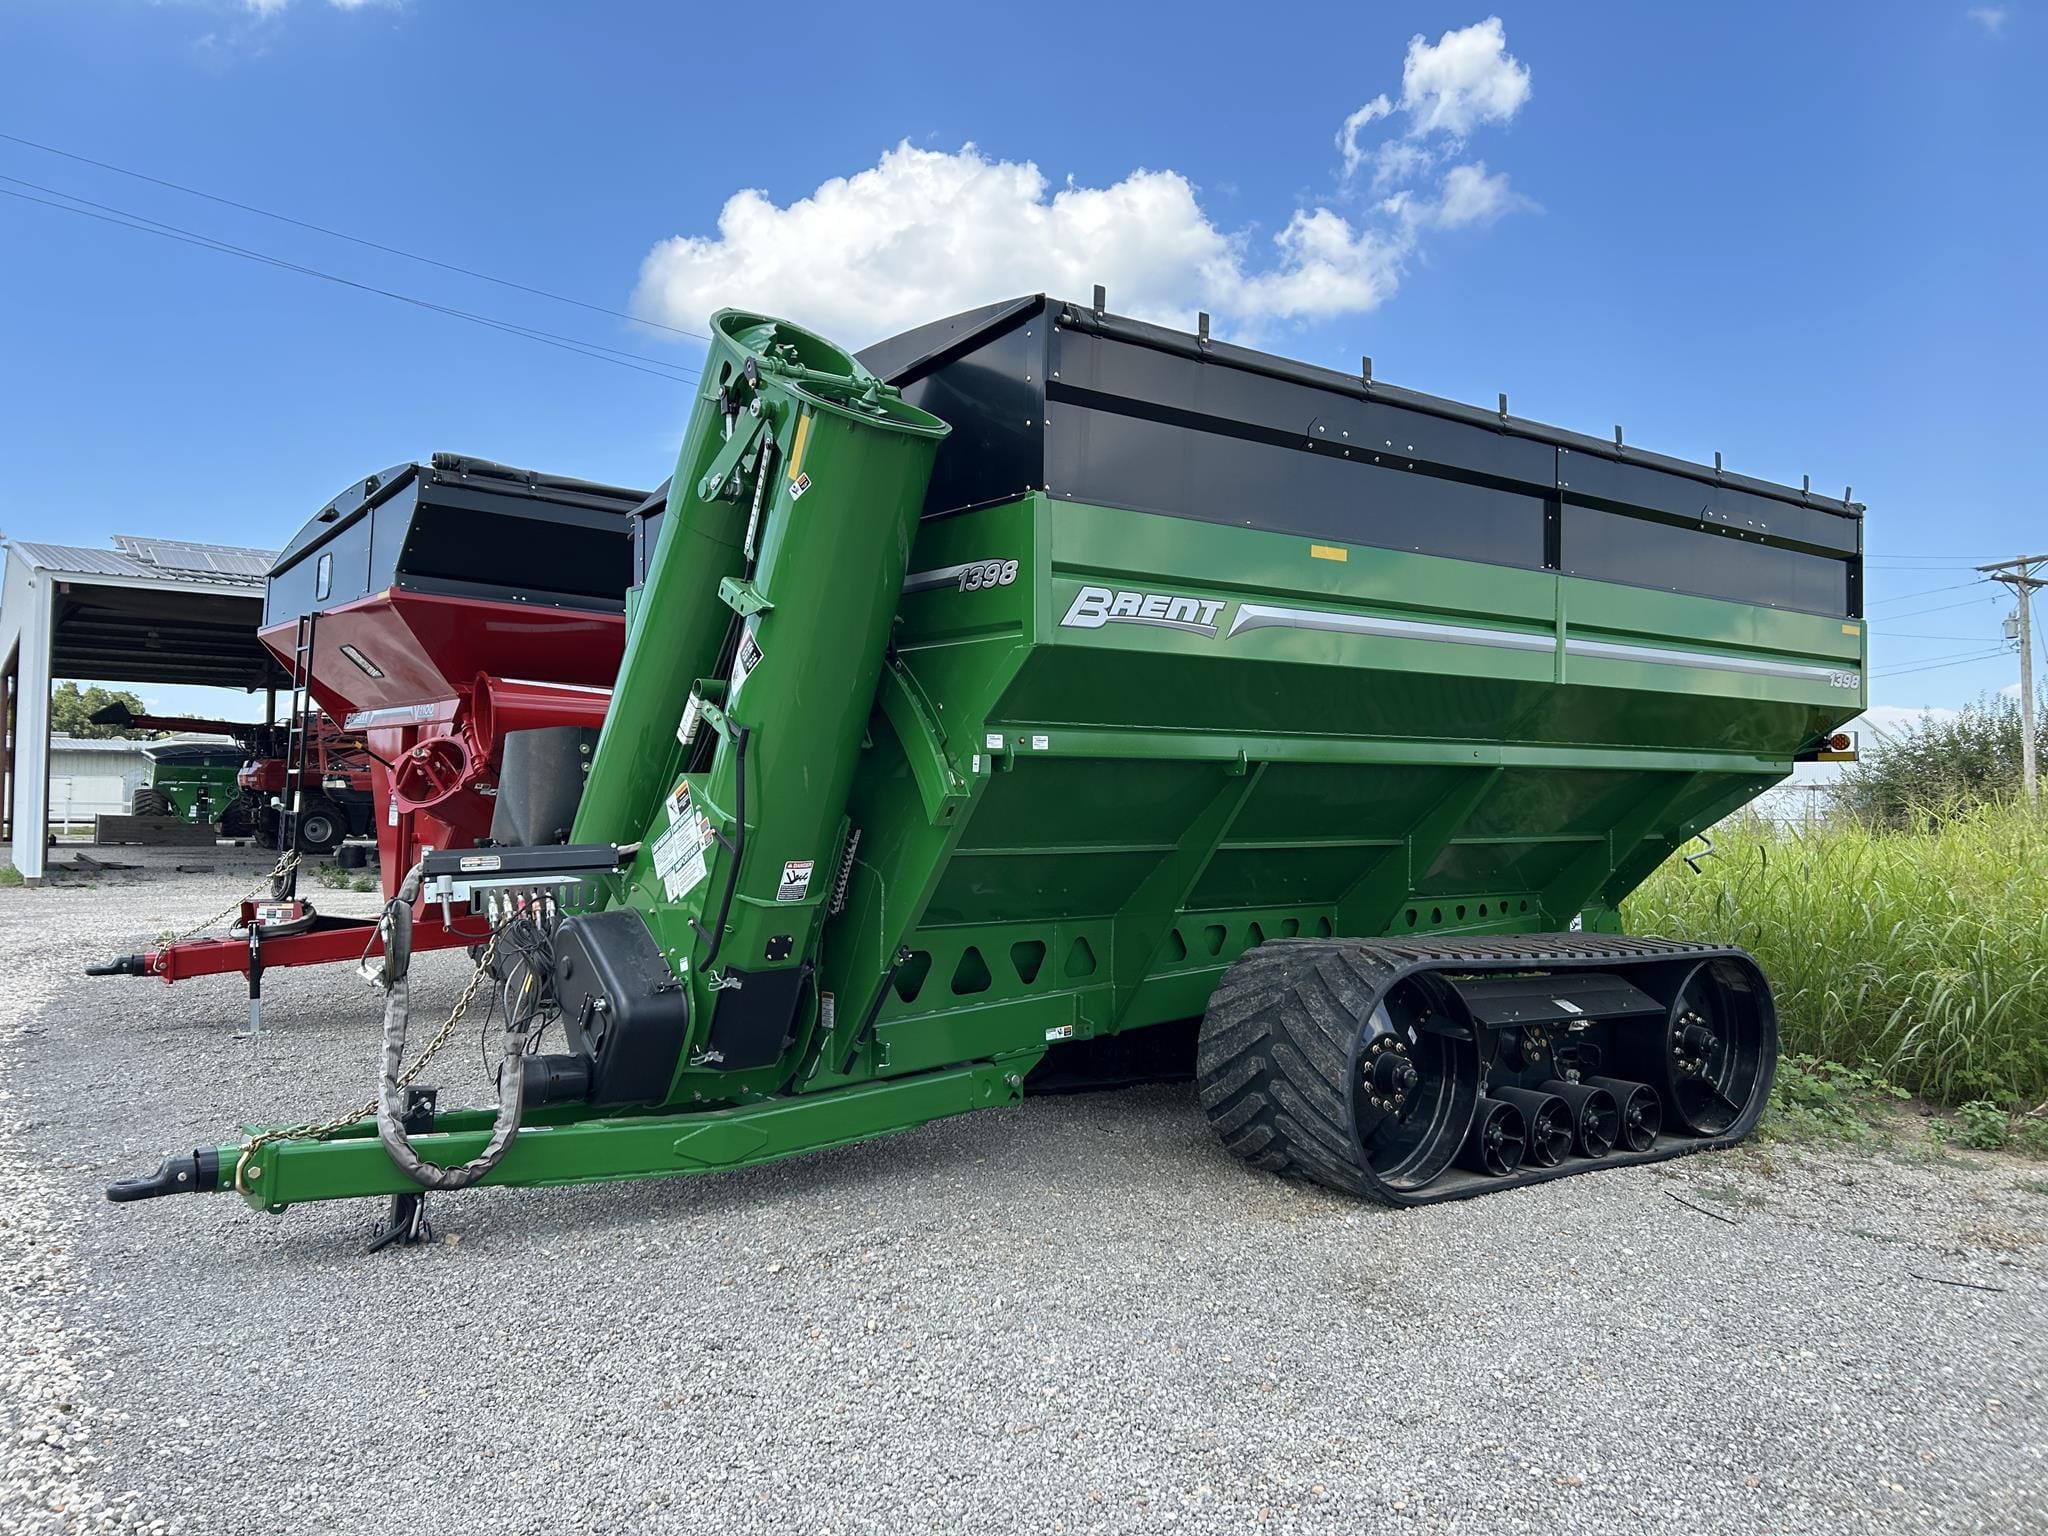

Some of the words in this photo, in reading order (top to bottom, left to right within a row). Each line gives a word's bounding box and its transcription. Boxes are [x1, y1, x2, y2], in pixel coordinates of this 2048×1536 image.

[957, 559, 1019, 593] 1398
[1058, 585, 1227, 638] BRENT
[1829, 672, 1860, 689] 1398
